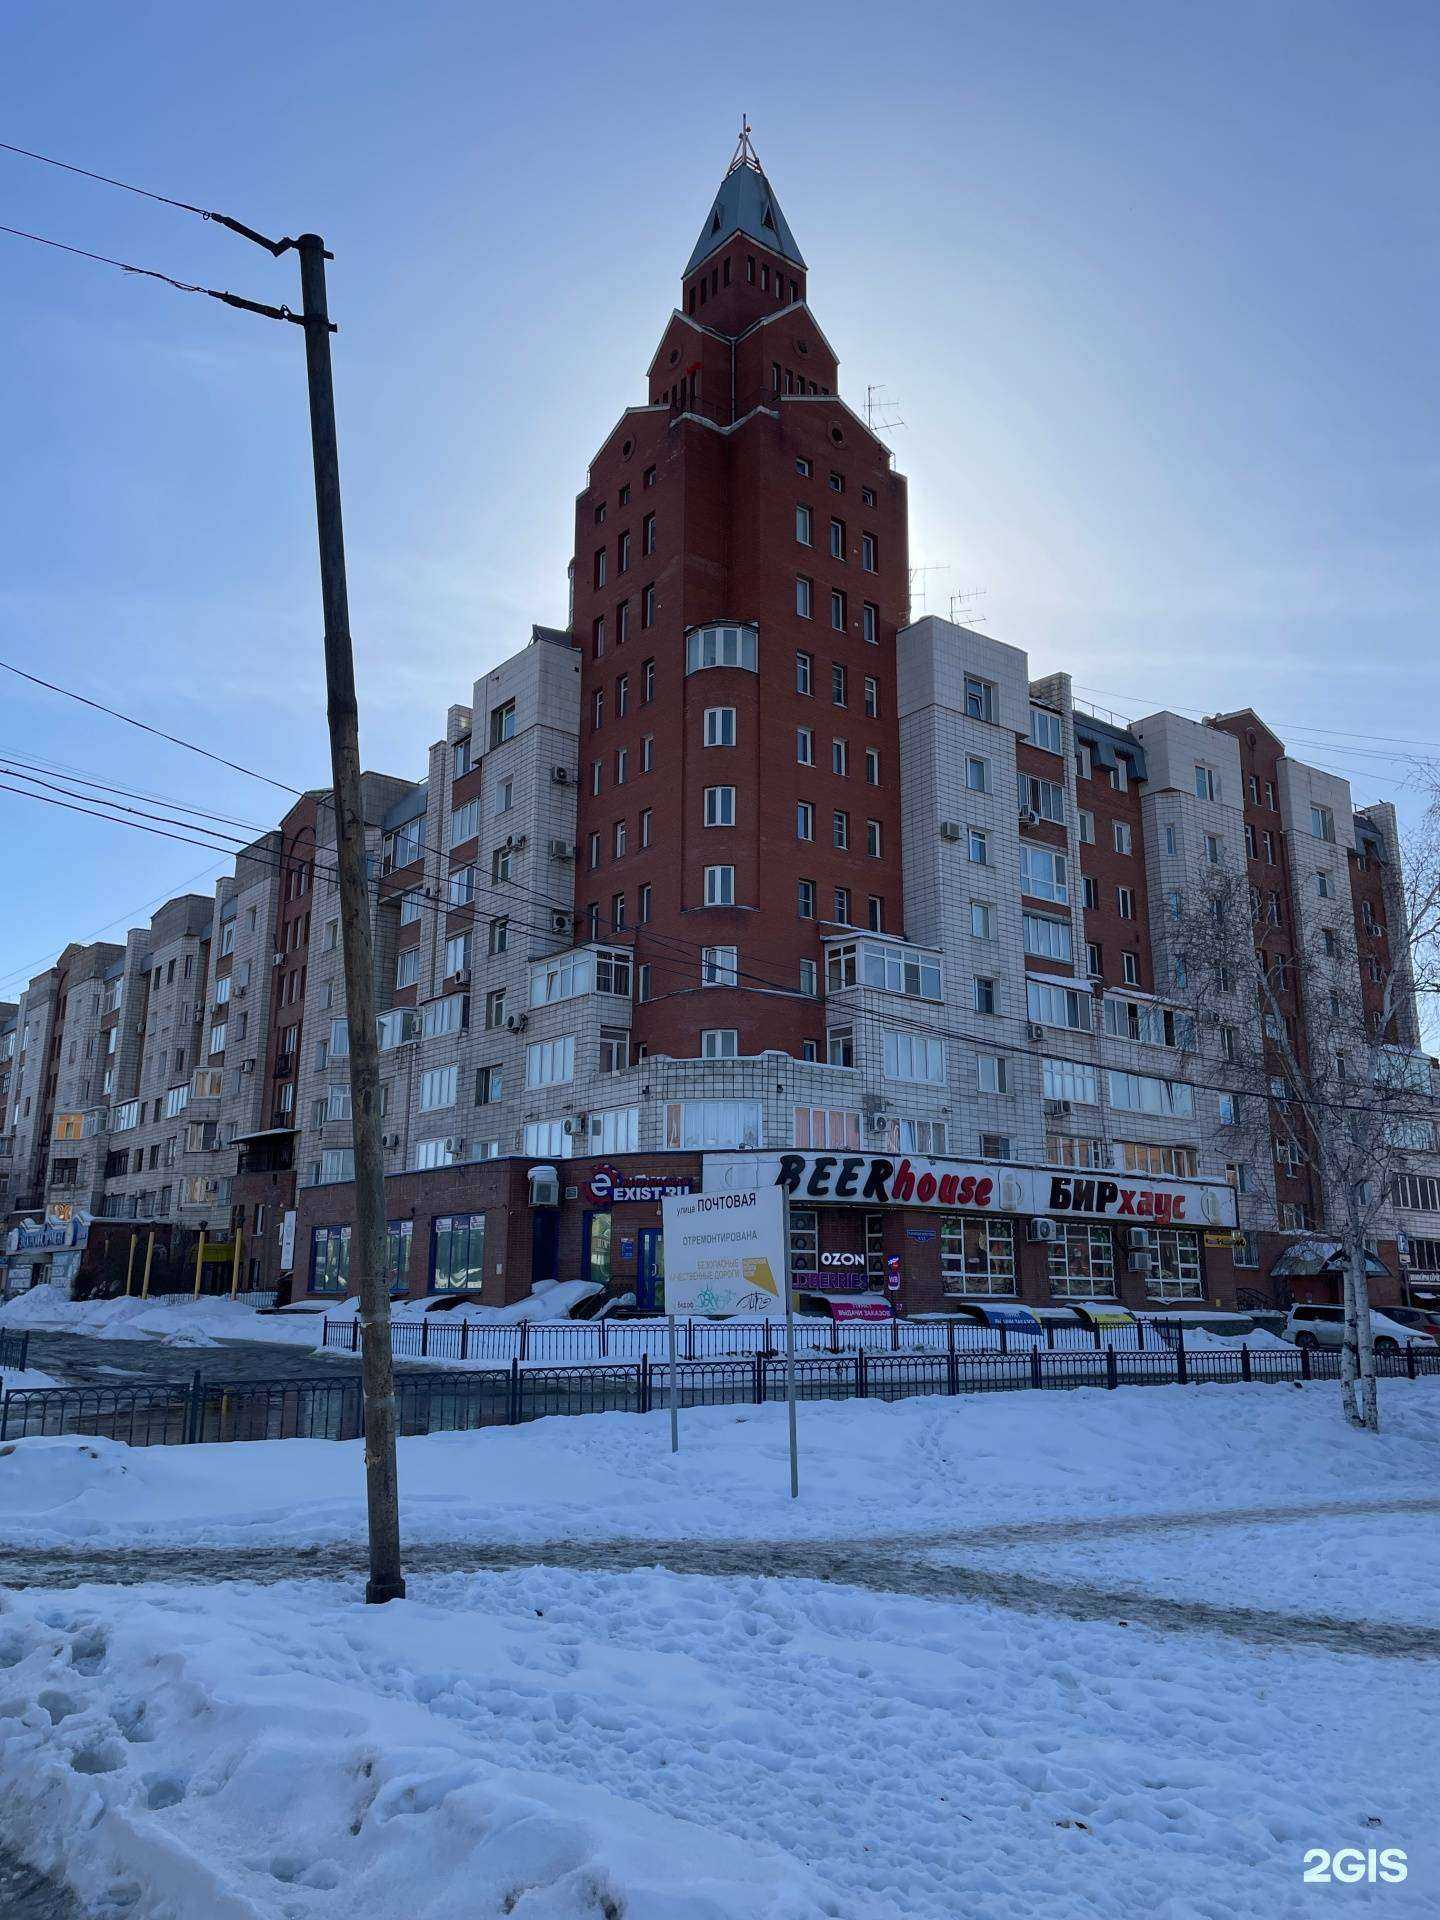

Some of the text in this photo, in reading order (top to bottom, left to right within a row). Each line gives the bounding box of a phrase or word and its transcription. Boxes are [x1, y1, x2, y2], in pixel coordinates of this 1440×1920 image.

[774, 1154, 994, 1207] BEERhouse
[676, 1192, 757, 1216] улица ПОЧТОВАЯ
[1050, 1176, 1186, 1224] БИРхаус
[682, 1229, 759, 1247] ОТРЕМОНТИРОВАНА
[821, 1253, 865, 1265] OZON
